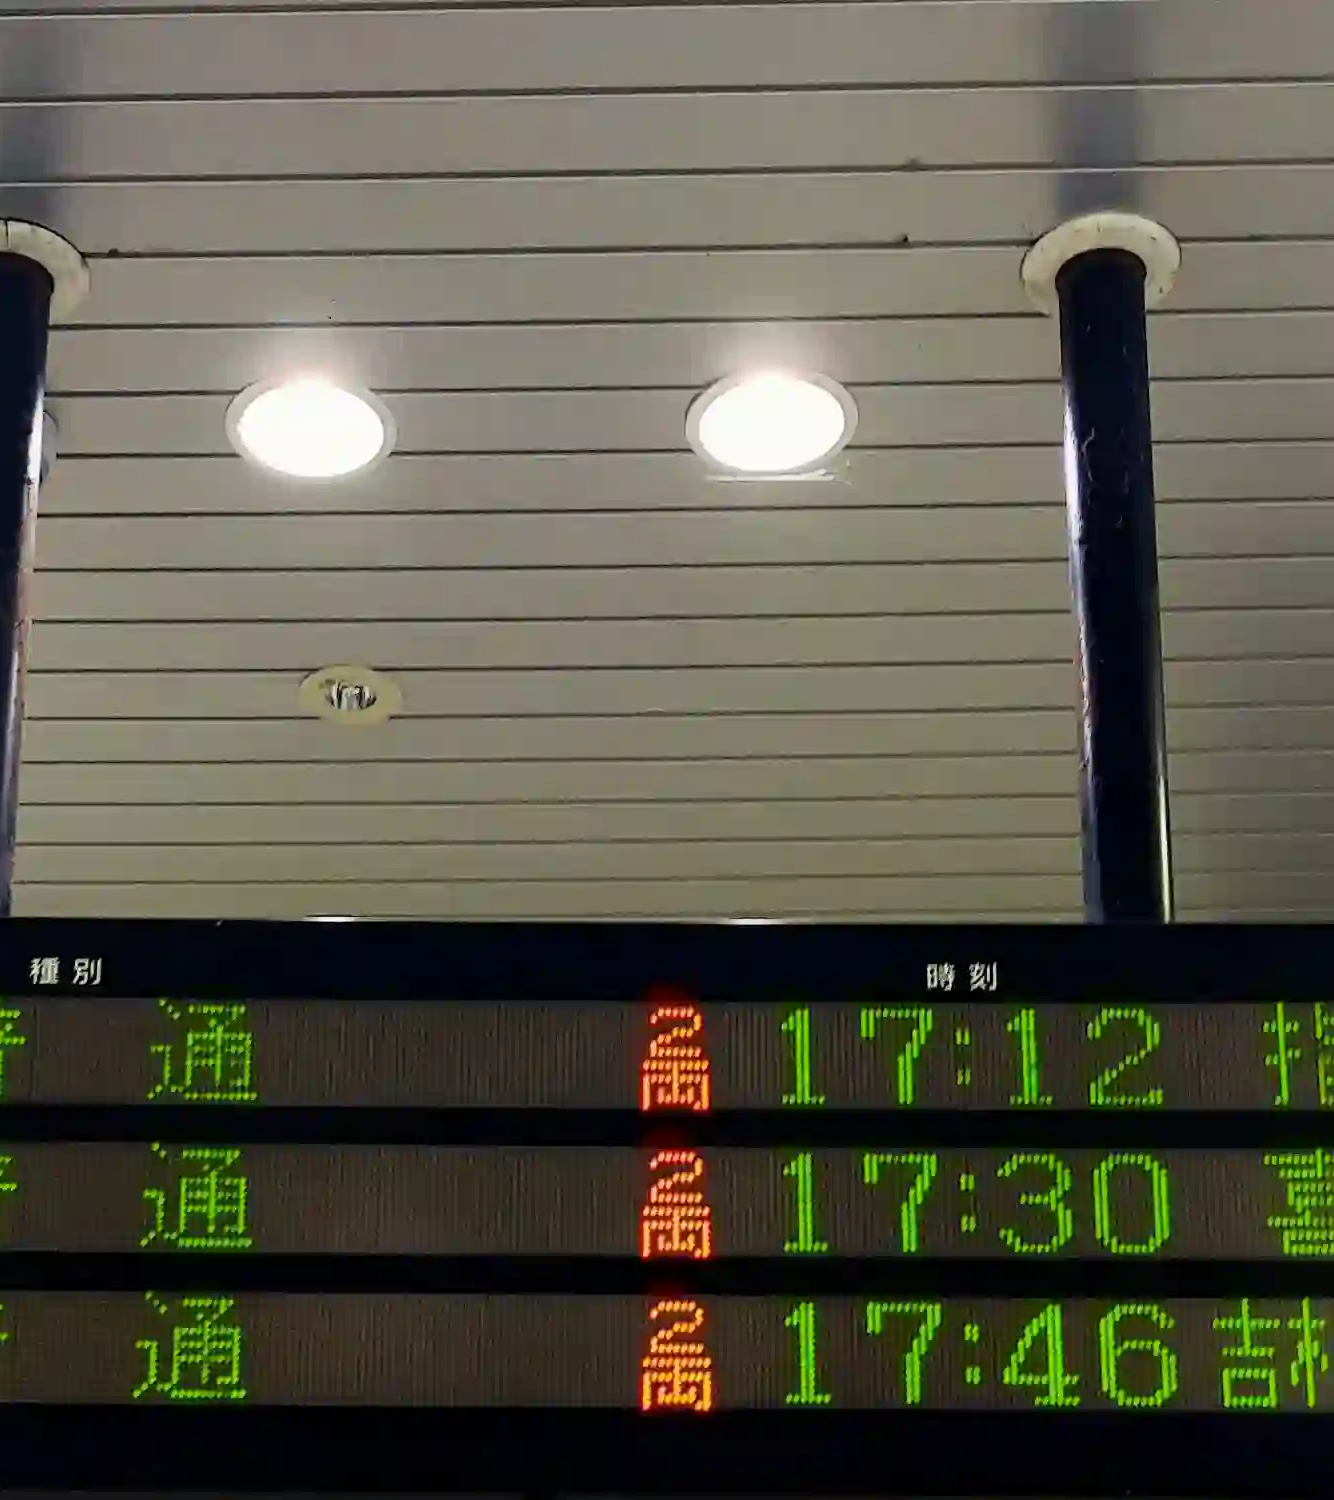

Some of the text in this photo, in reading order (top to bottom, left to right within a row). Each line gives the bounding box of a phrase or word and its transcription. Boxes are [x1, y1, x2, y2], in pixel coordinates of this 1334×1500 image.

[29, 957, 102, 985] 種別
[926, 963, 998, 991] 時刻
[780, 1007, 1165, 1106] 17:12
[783, 1152, 1171, 1254] 17:30
[784, 1302, 1179, 1408] 17:46
